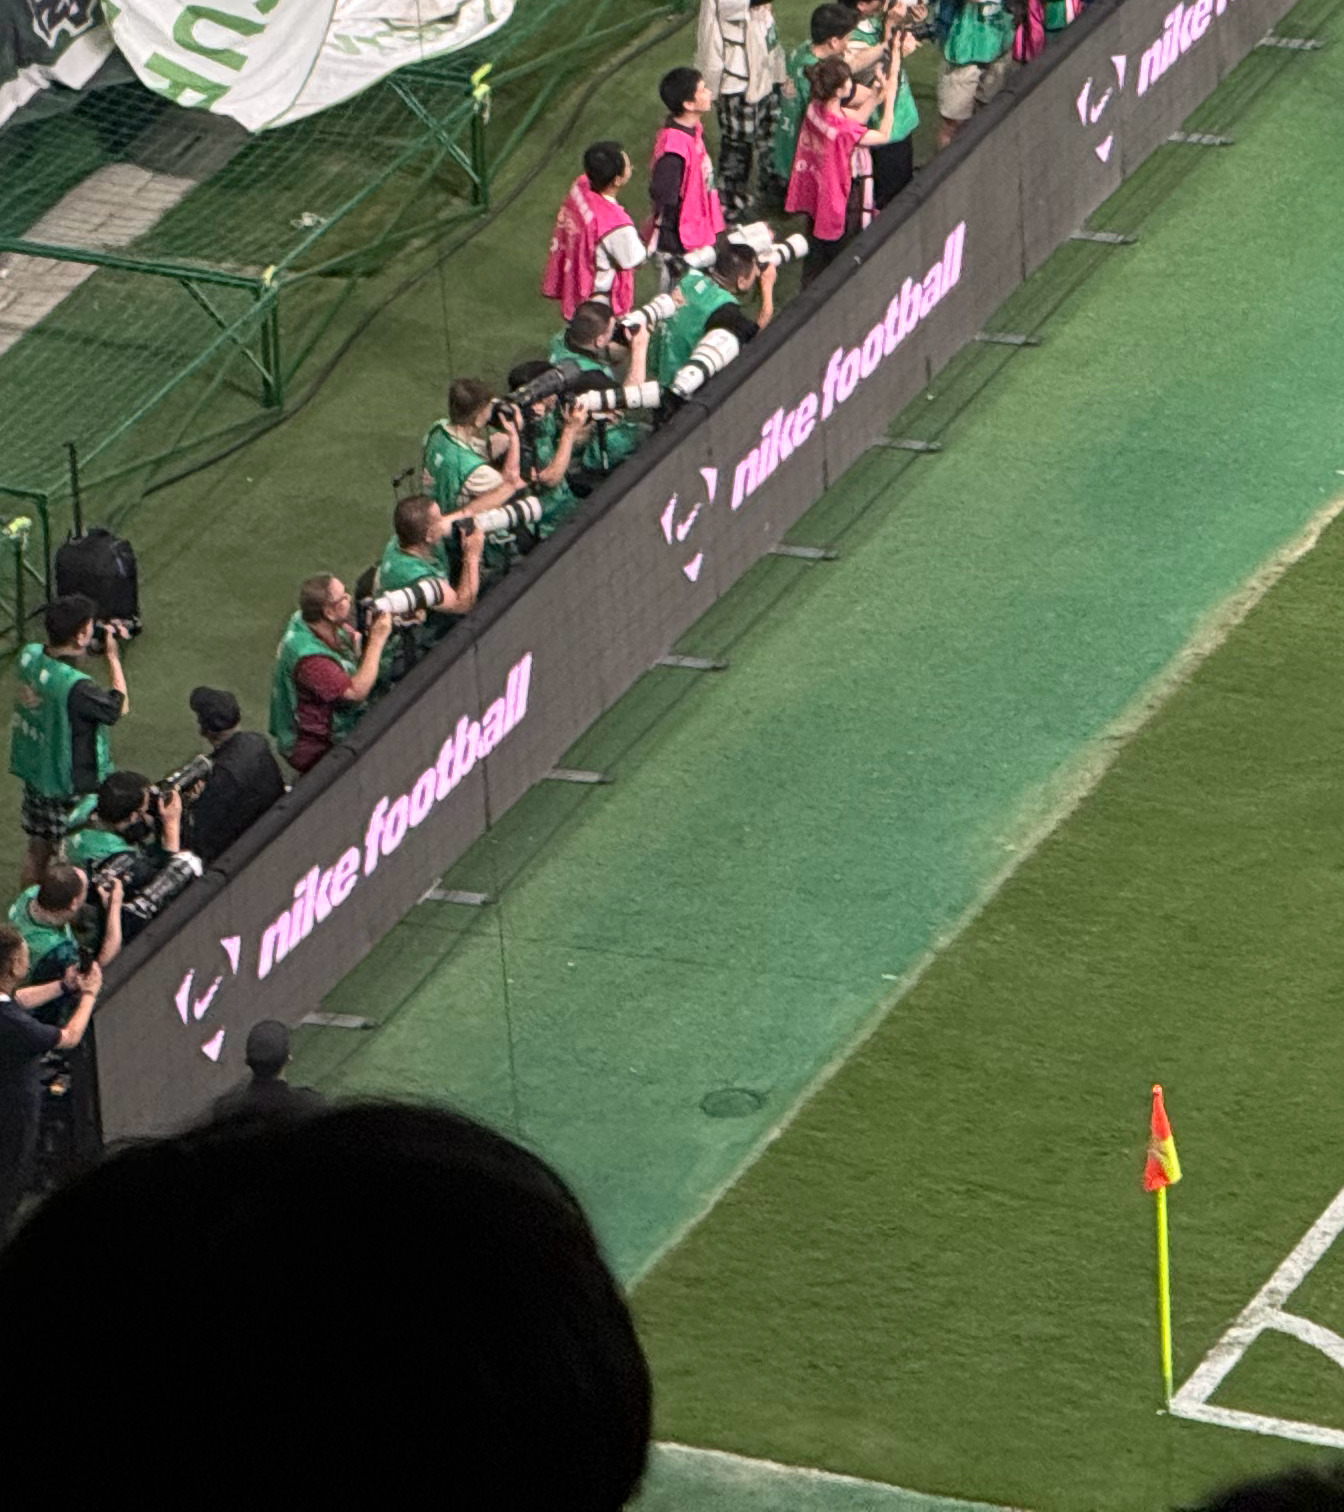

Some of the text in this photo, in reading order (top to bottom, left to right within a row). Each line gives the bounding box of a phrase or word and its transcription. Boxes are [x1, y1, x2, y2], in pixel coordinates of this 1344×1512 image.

[731, 219, 966, 510] nike football
[258, 650, 533, 980] nike football
